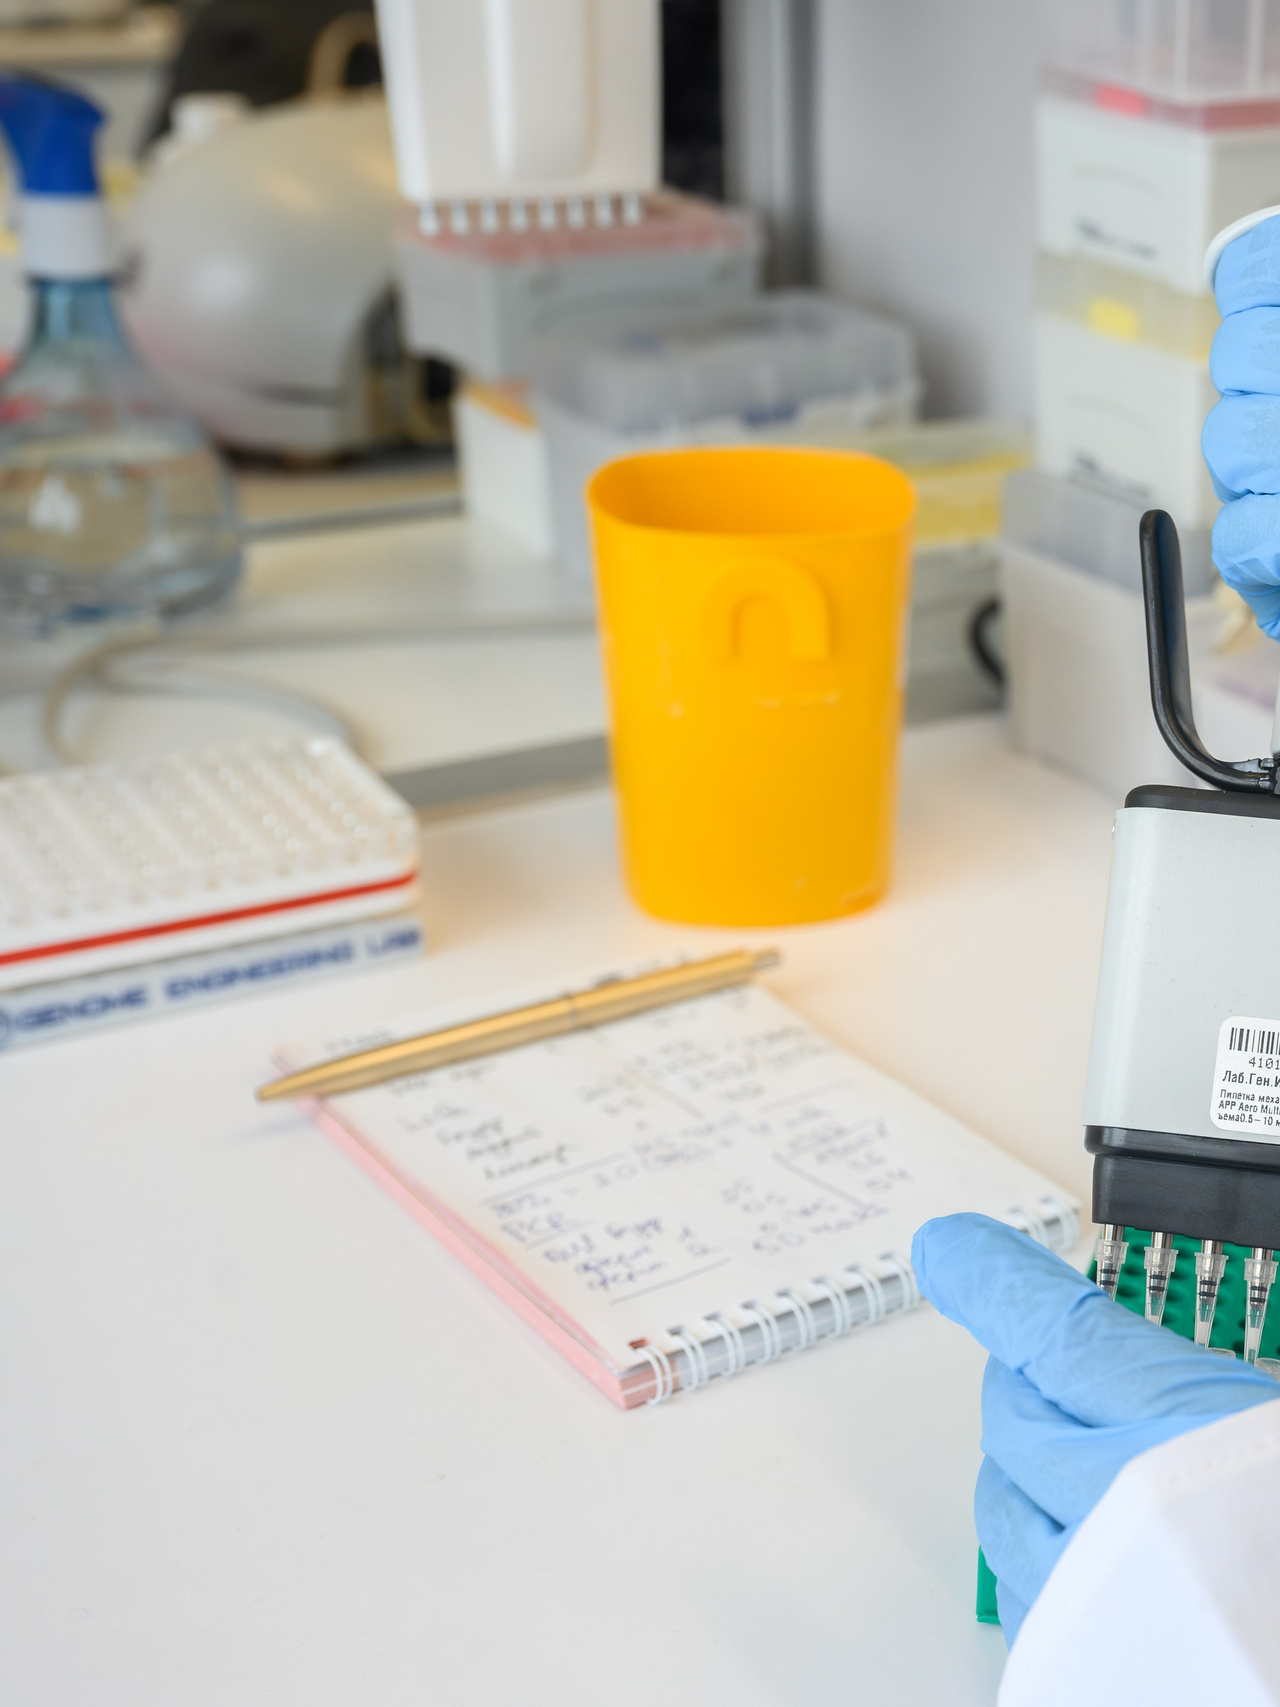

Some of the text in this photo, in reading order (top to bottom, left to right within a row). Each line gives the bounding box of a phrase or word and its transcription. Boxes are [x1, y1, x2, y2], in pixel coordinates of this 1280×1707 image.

[17, 985, 148, 1033] GENOME
[164, 938, 355, 999] ENGINEERING
[1220, 1088, 1255, 1101] Пипетка
[1218, 1099, 1236, 1110] APP
[1238, 1102, 1258, 1113] Aero
[1263, 1116, 1273, 1126] 10
